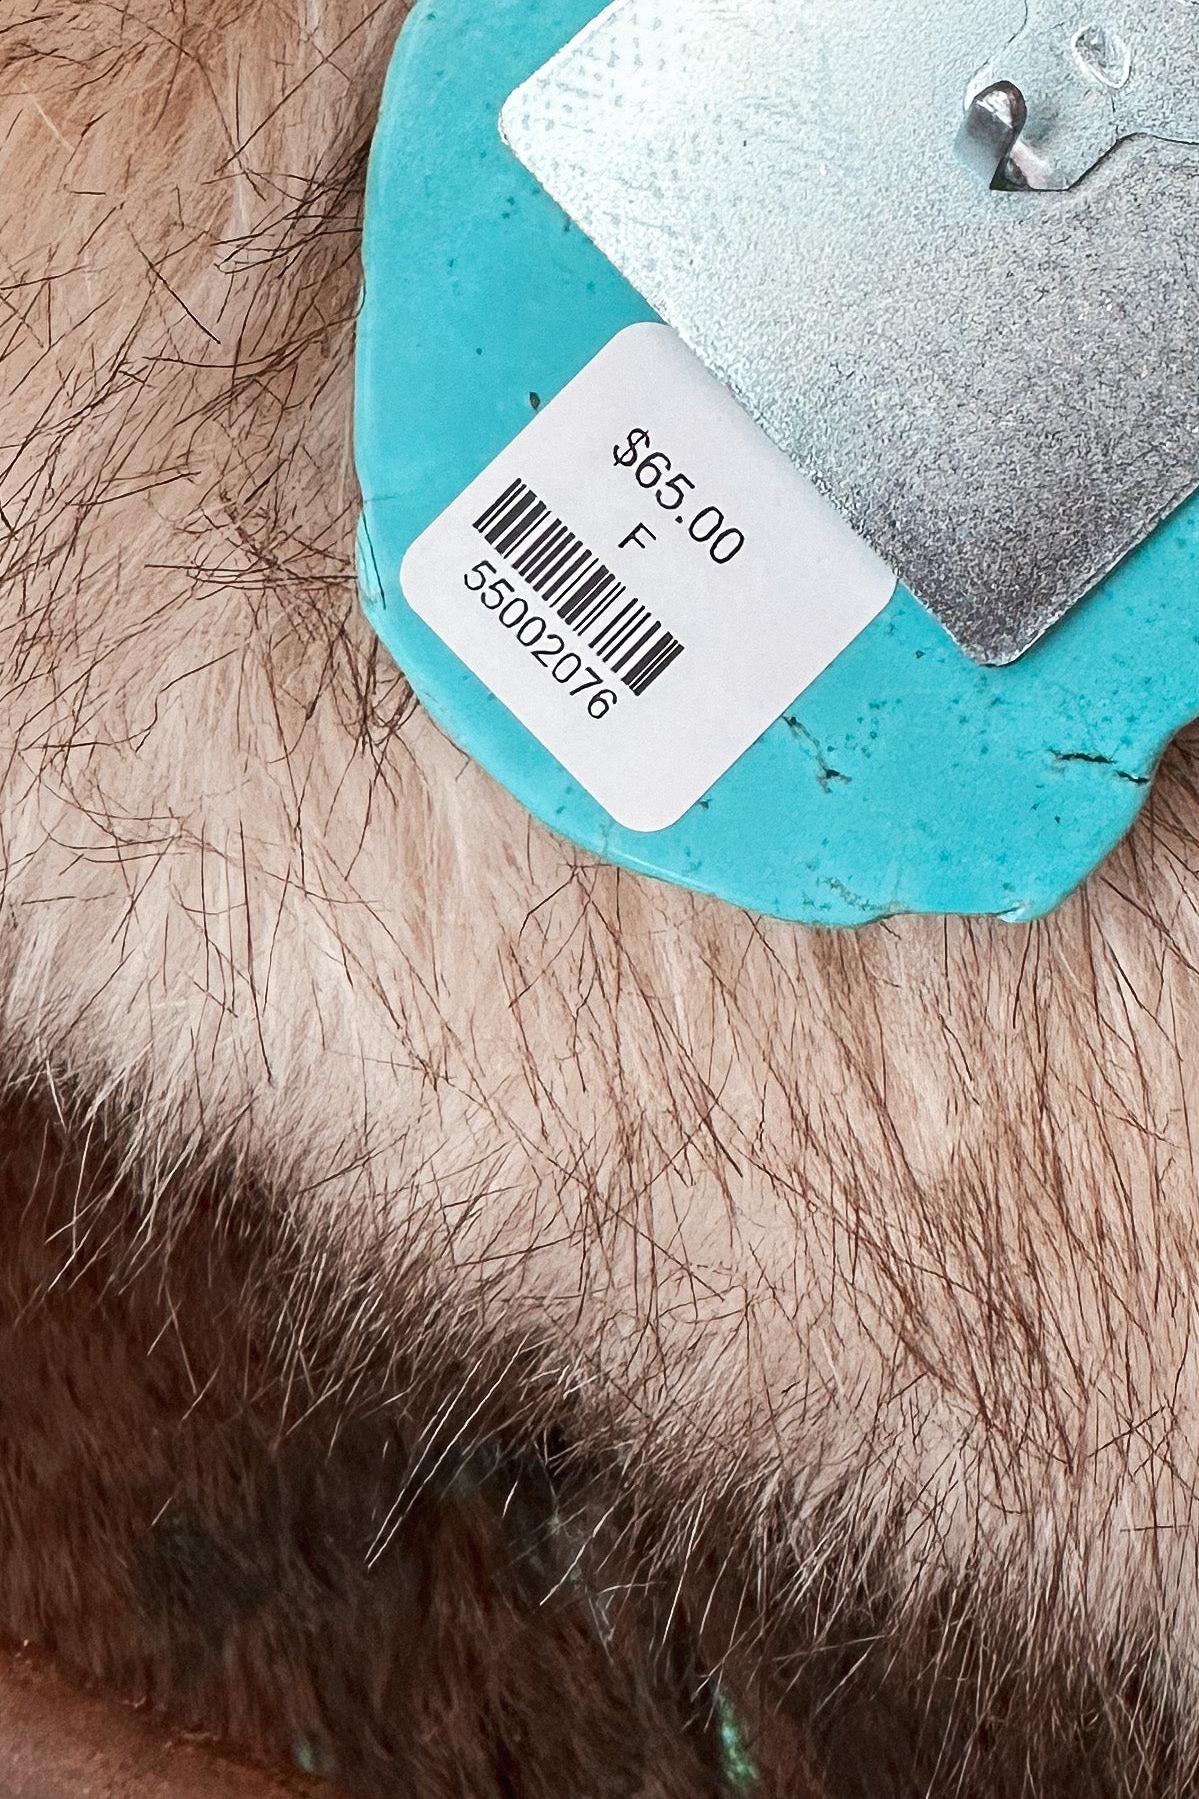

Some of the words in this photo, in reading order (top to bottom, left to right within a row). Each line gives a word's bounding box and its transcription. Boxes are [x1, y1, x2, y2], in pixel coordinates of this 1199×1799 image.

[612, 427, 745, 565] $65.00
[617, 522, 657, 550] F
[463, 559, 618, 720] 55002076
